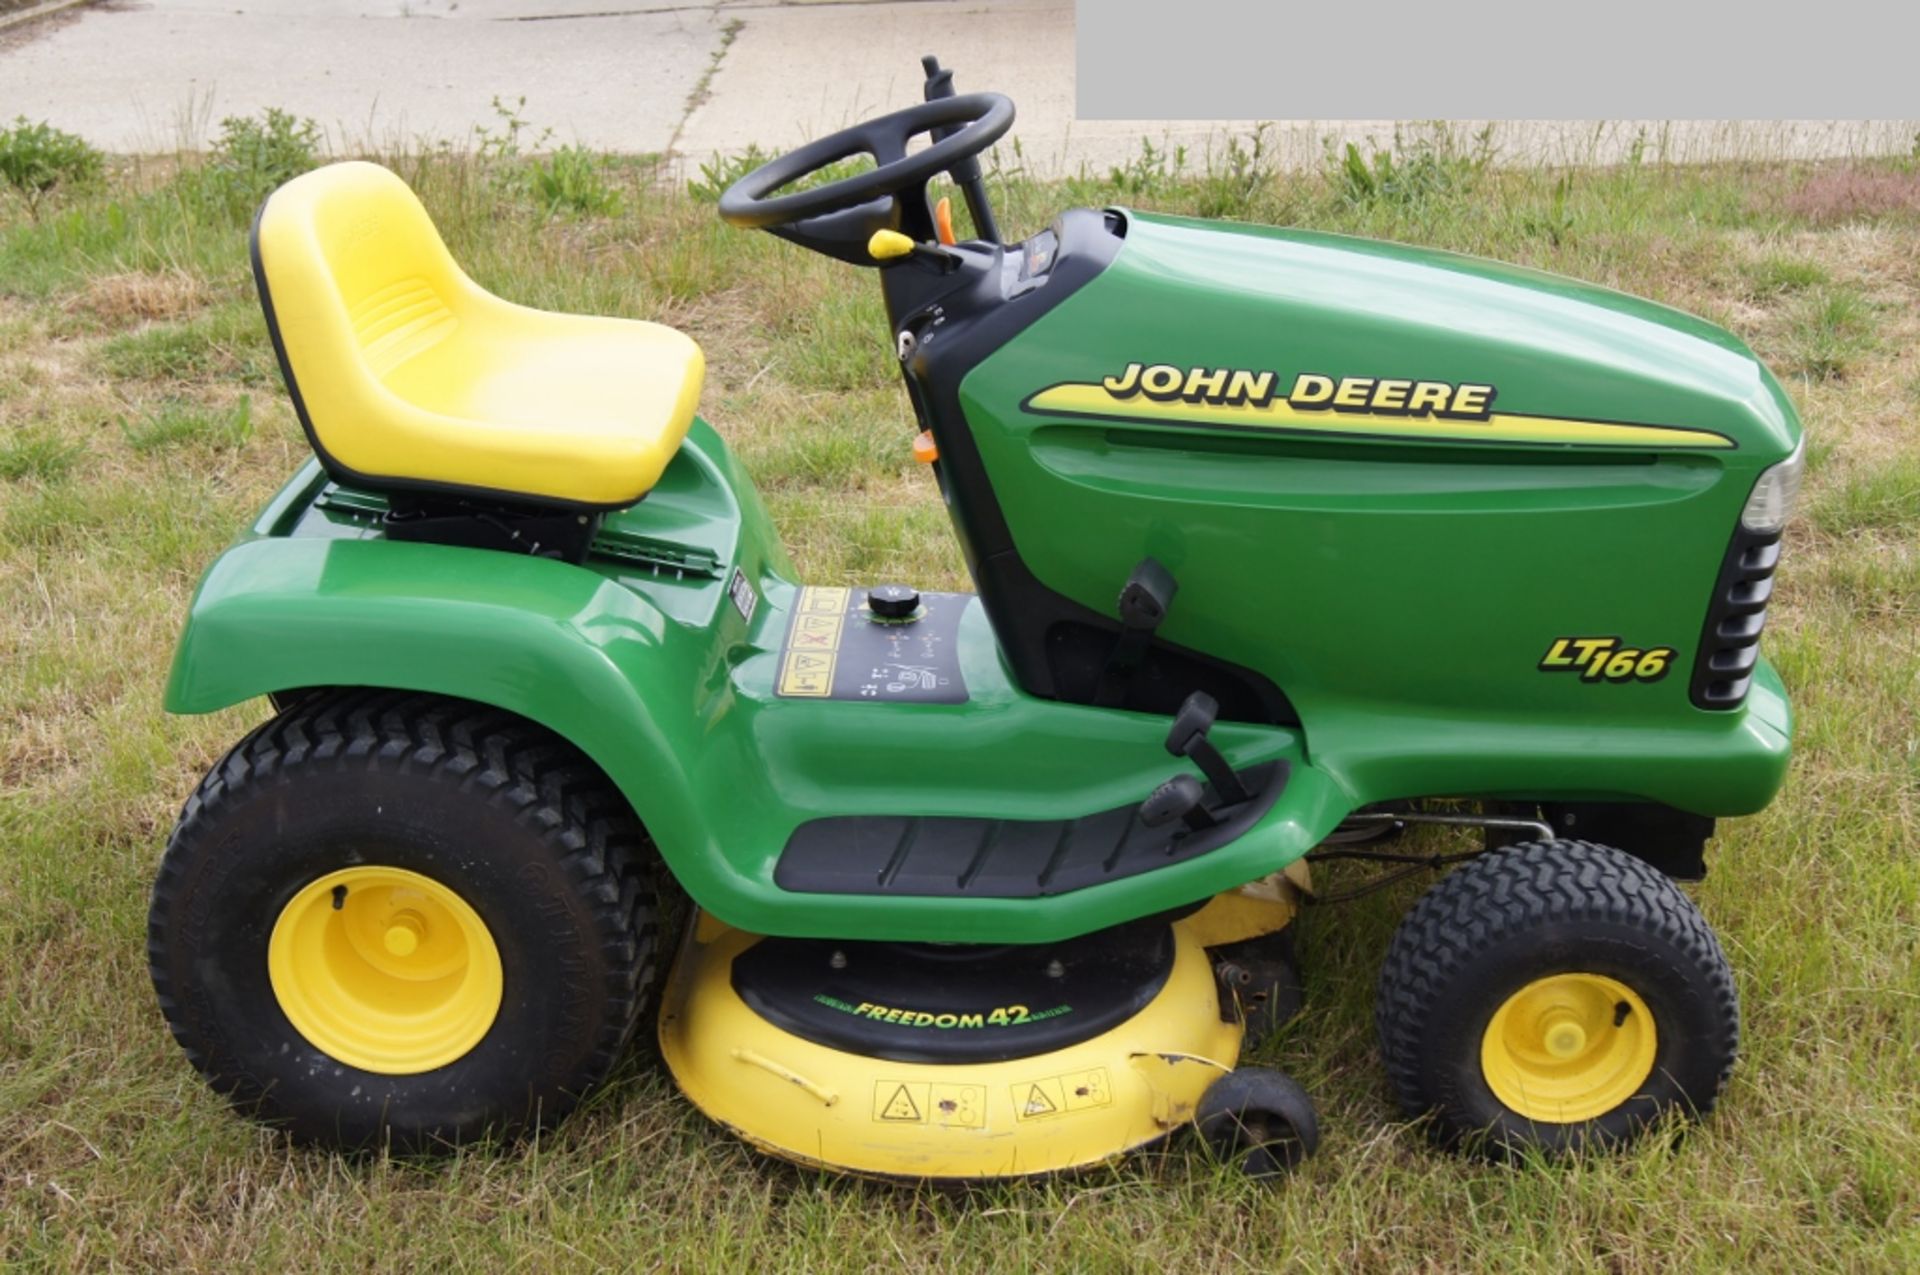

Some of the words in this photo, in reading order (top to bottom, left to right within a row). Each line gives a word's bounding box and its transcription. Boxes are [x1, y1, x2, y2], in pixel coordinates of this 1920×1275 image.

[1102, 362, 1277, 406] JOHN
[1288, 373, 1497, 420] DEERE
[1540, 638, 1674, 681] LT166
